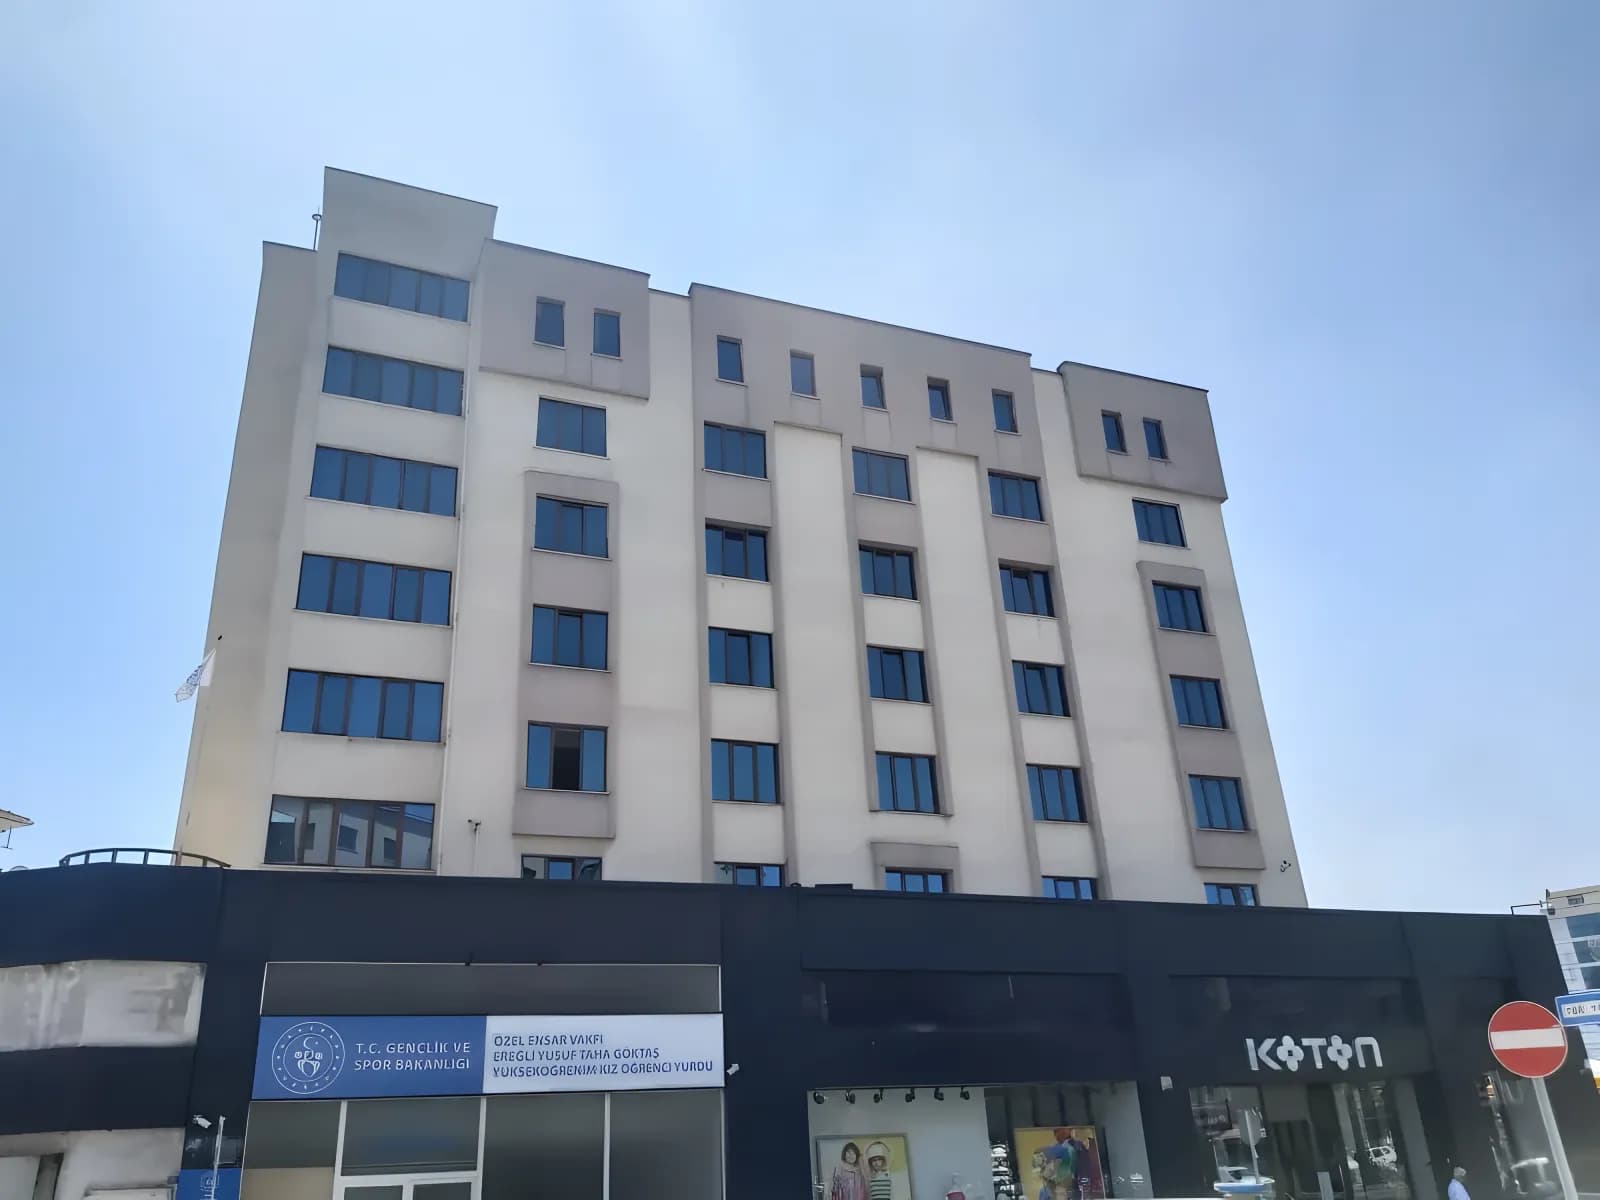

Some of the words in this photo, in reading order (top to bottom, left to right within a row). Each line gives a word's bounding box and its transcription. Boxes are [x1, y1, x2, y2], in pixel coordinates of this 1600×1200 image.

[355, 1042, 381, 1054] T.C.
[454, 1042, 471, 1053] VE
[1245, 1035, 1383, 1071] KOTON
[538, 1050, 577, 1061] YUSUF
[354, 1059, 391, 1071] SPOR
[673, 1060, 713, 1072] YURDU
